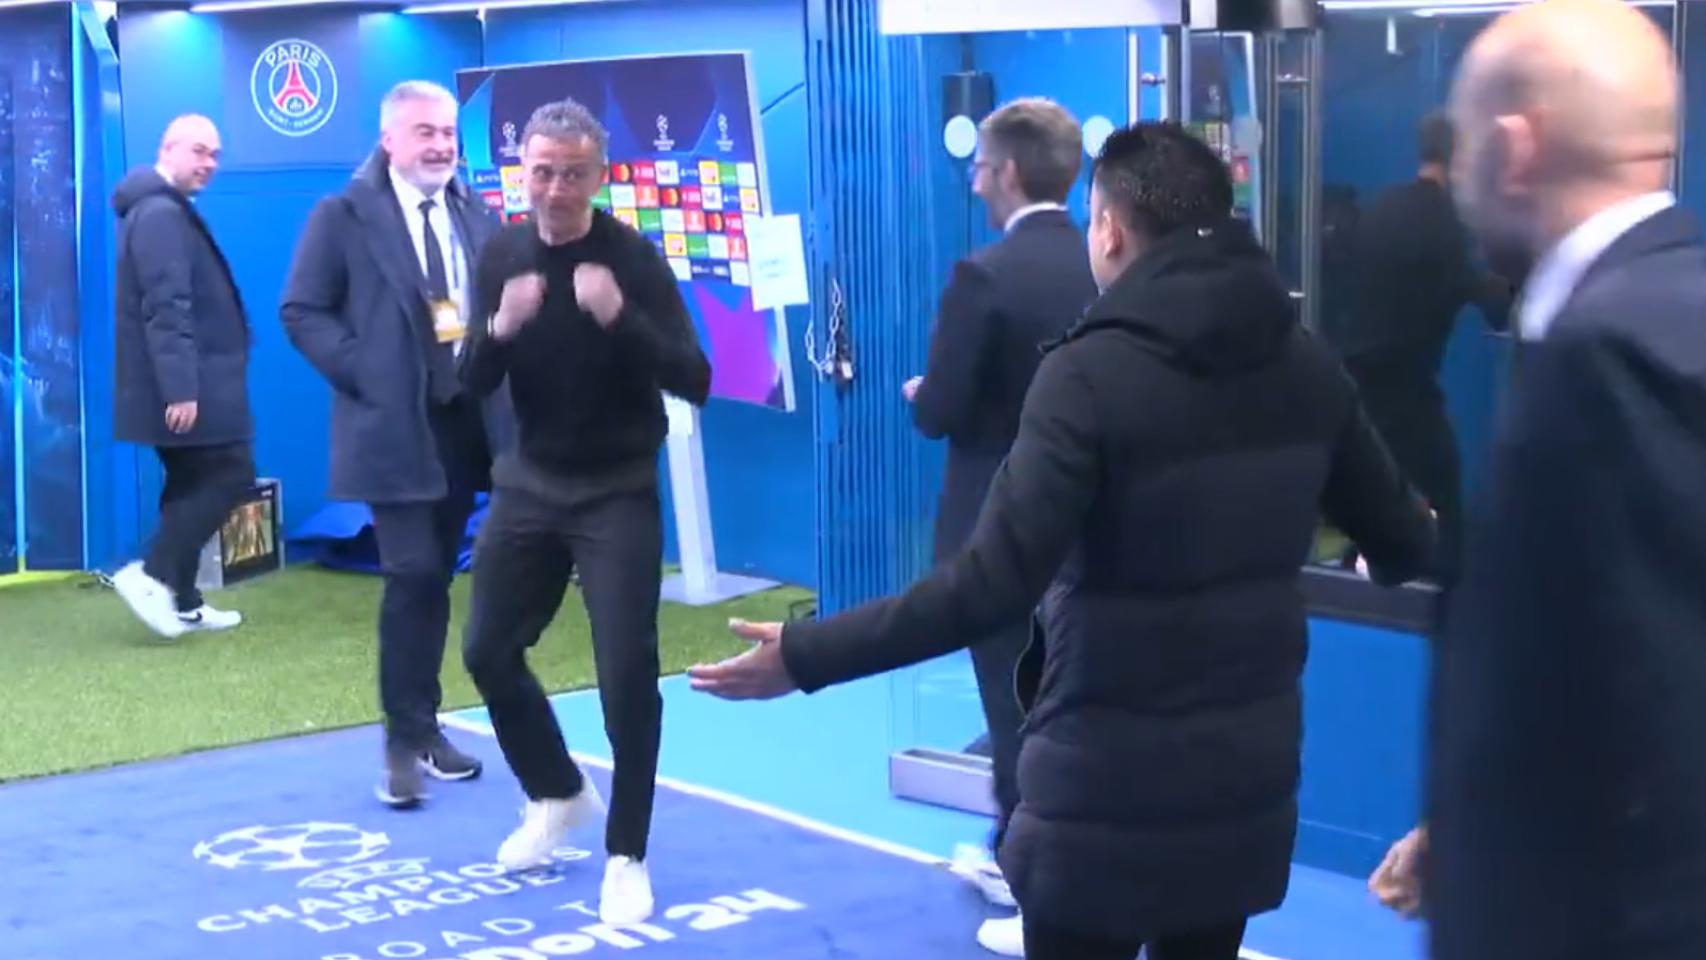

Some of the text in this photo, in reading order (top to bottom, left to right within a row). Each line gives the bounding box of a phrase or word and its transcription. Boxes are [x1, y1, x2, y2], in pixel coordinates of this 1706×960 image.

[265, 45, 321, 67] PARIS
[197, 848, 592, 932] CHAMPIOS
[664, 888, 806, 931] 24
